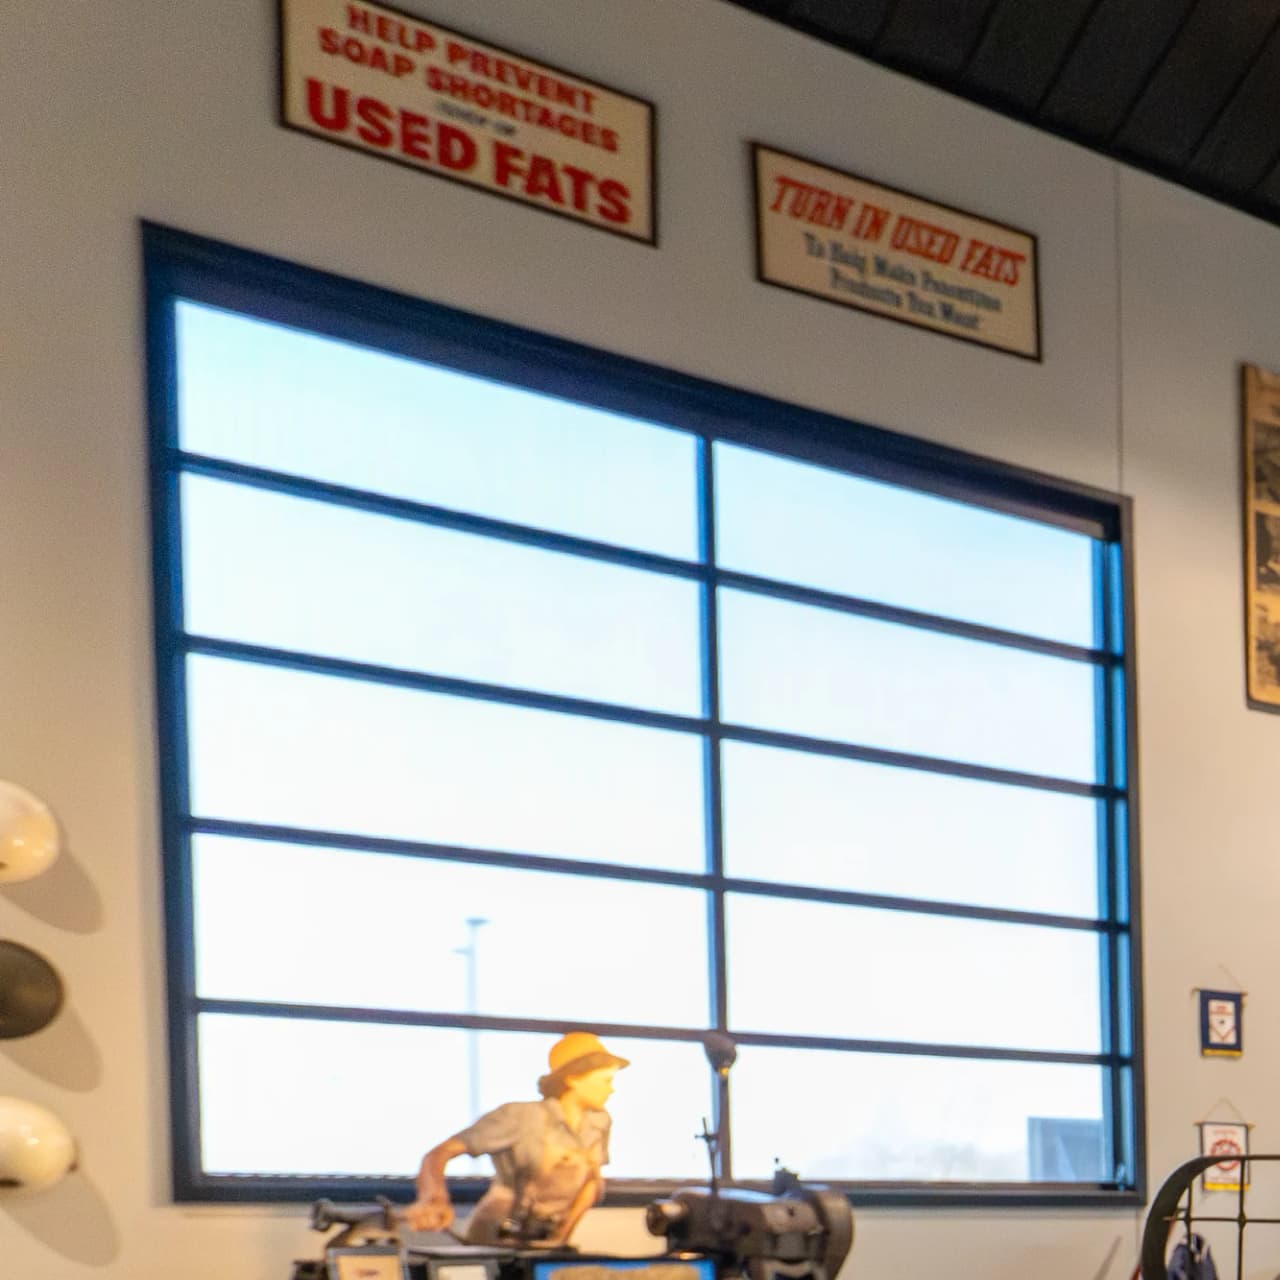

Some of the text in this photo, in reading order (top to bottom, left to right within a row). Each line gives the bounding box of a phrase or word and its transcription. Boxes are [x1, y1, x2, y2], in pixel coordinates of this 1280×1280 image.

[318, 27, 415, 77] SOAP
[425, 66, 618, 154] SHORTAGES
[347, 4, 593, 114] HELP PREVENT
[304, 76, 478, 172] USED
[490, 139, 631, 224] FATS
[770, 175, 1026, 288] TURN IN USED FATS
